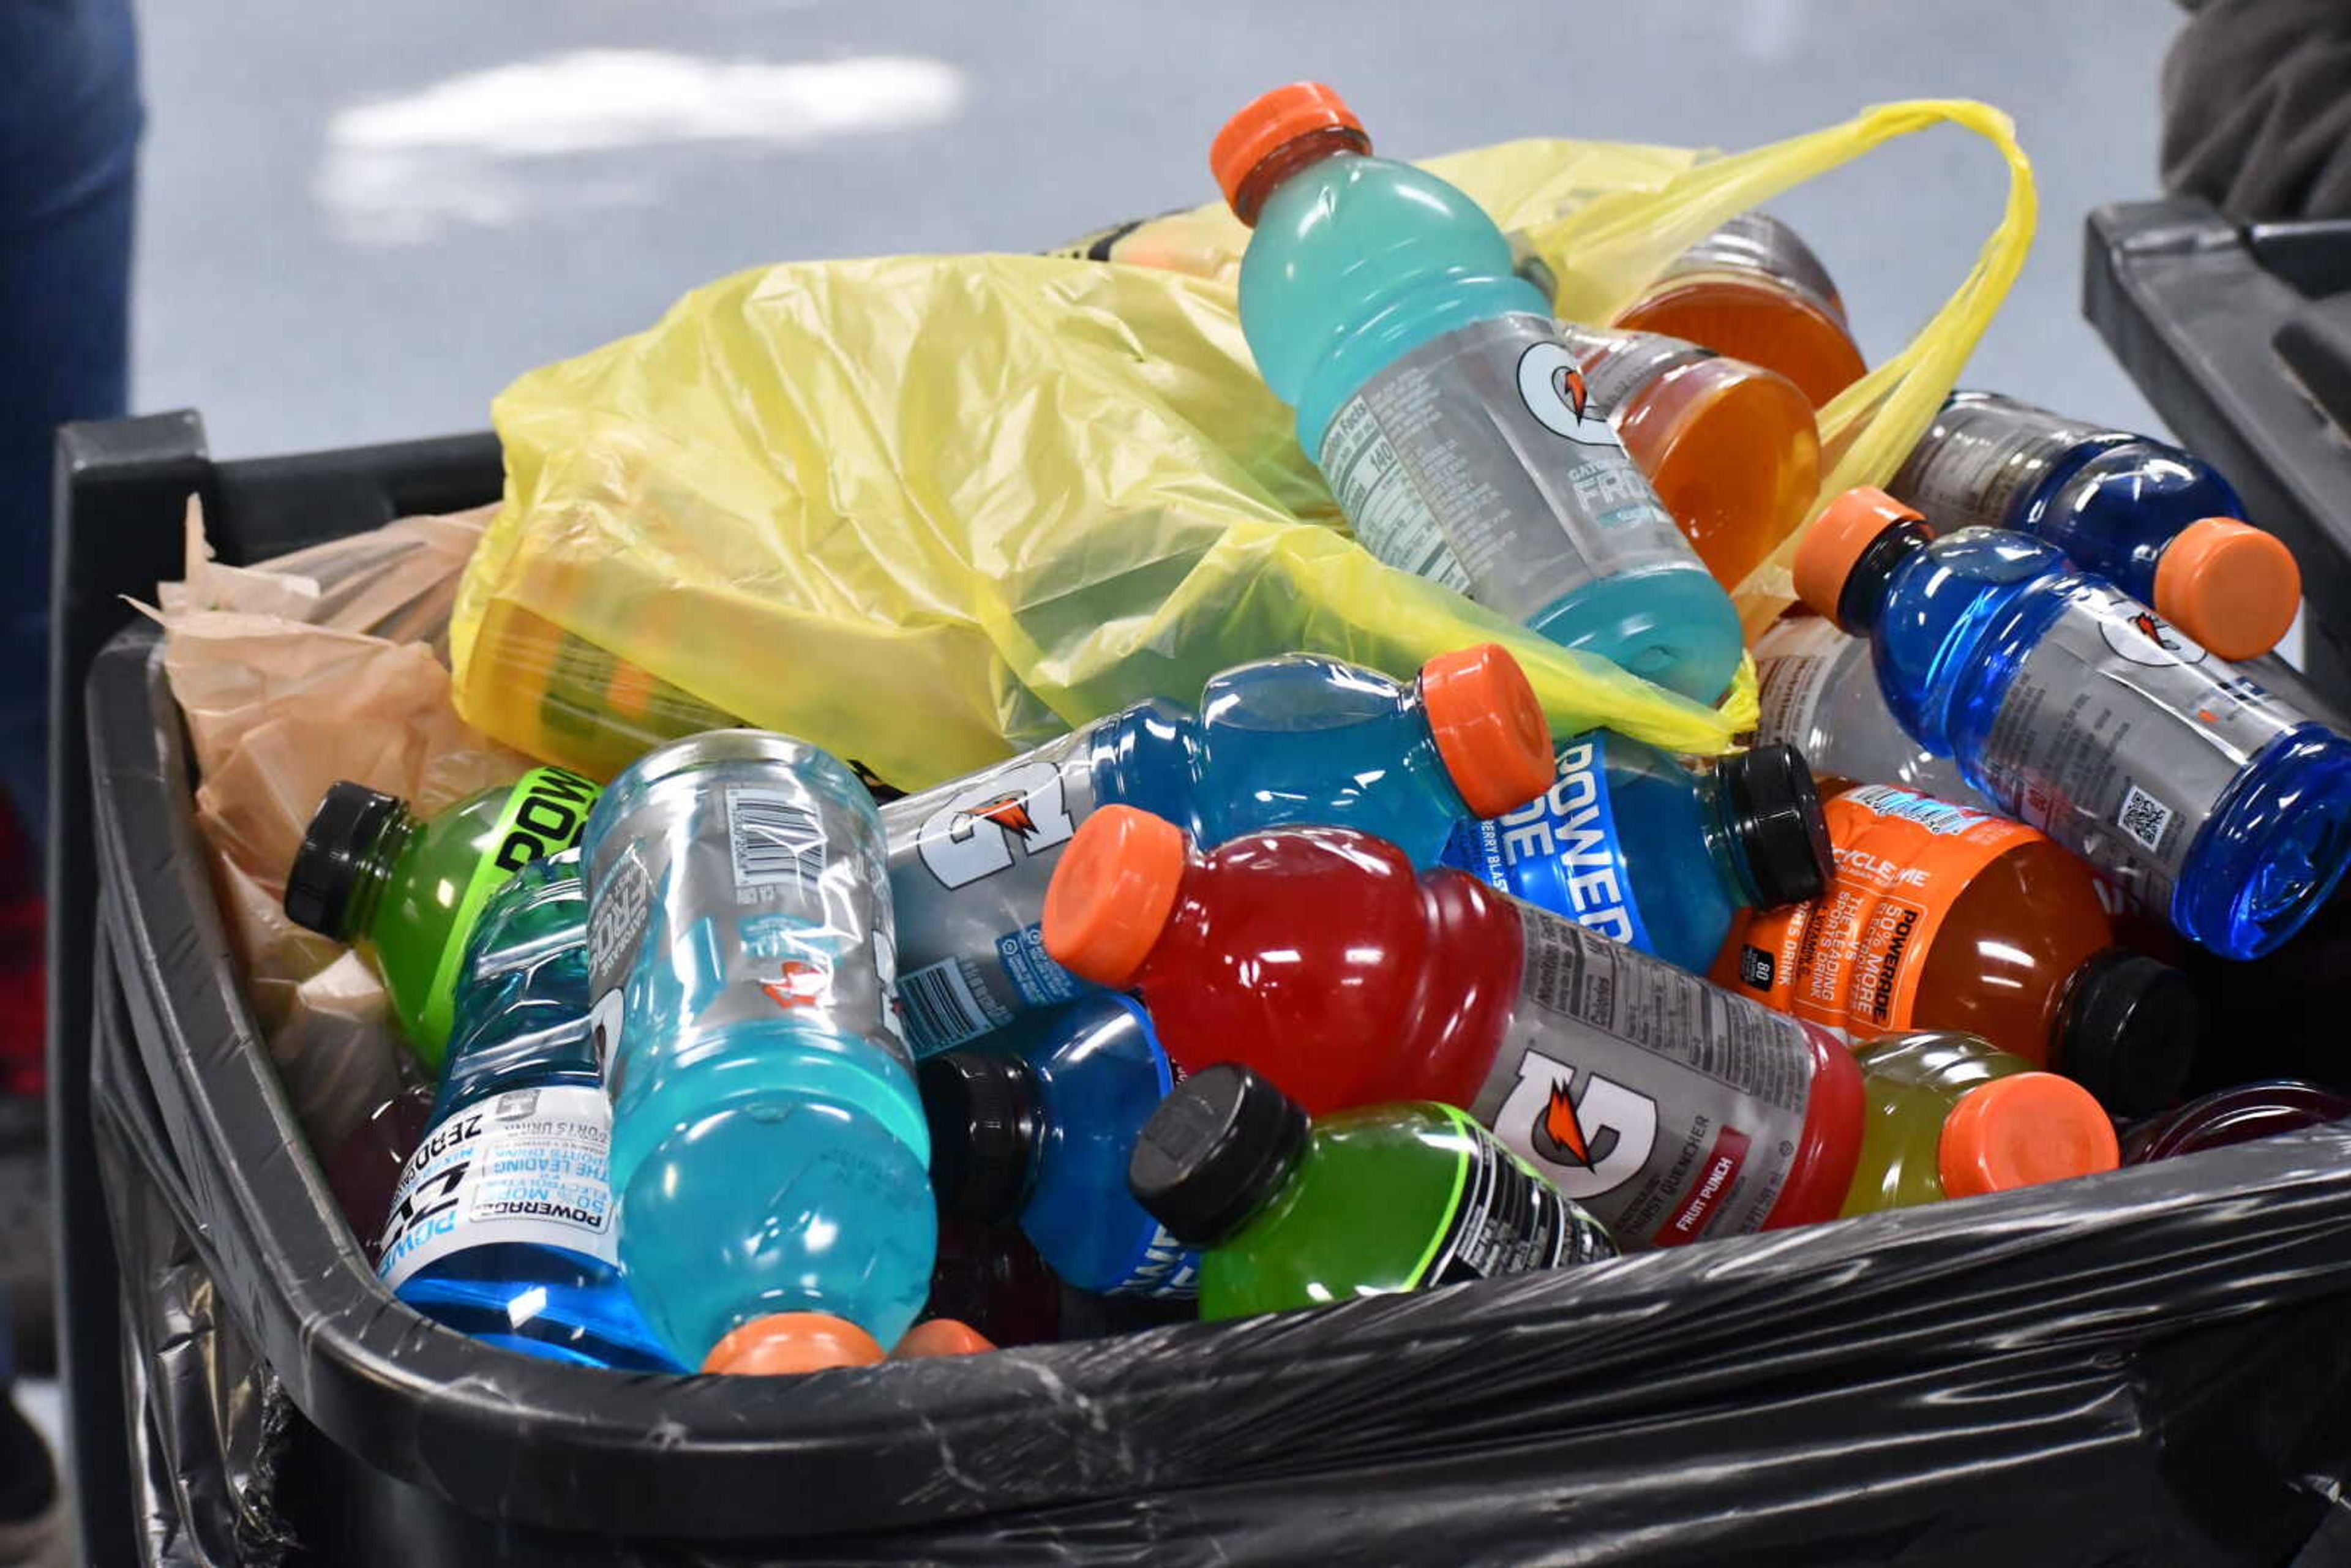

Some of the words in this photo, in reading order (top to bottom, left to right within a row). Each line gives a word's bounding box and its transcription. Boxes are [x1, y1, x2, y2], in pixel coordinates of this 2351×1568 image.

[1822, 891, 1850, 947] SPORTS
[1872, 904, 1903, 947] 50%
[1756, 961, 1771, 981] 80
[1778, 940, 1798, 985] DRINK
[1810, 951, 1828, 999] DRINK
[1822, 926, 1850, 1000] LEADING
[1857, 953, 1884, 1015] MORE
[1873, 909, 1918, 1021] POWERADE
[416, 1114, 482, 1171] ZERO
[1493, 1048, 1658, 1199] G
[493, 1158, 570, 1174] LEADING
[1676, 1196, 1708, 1231] FRUIT
[1700, 1157, 1734, 1199] PUNCH
